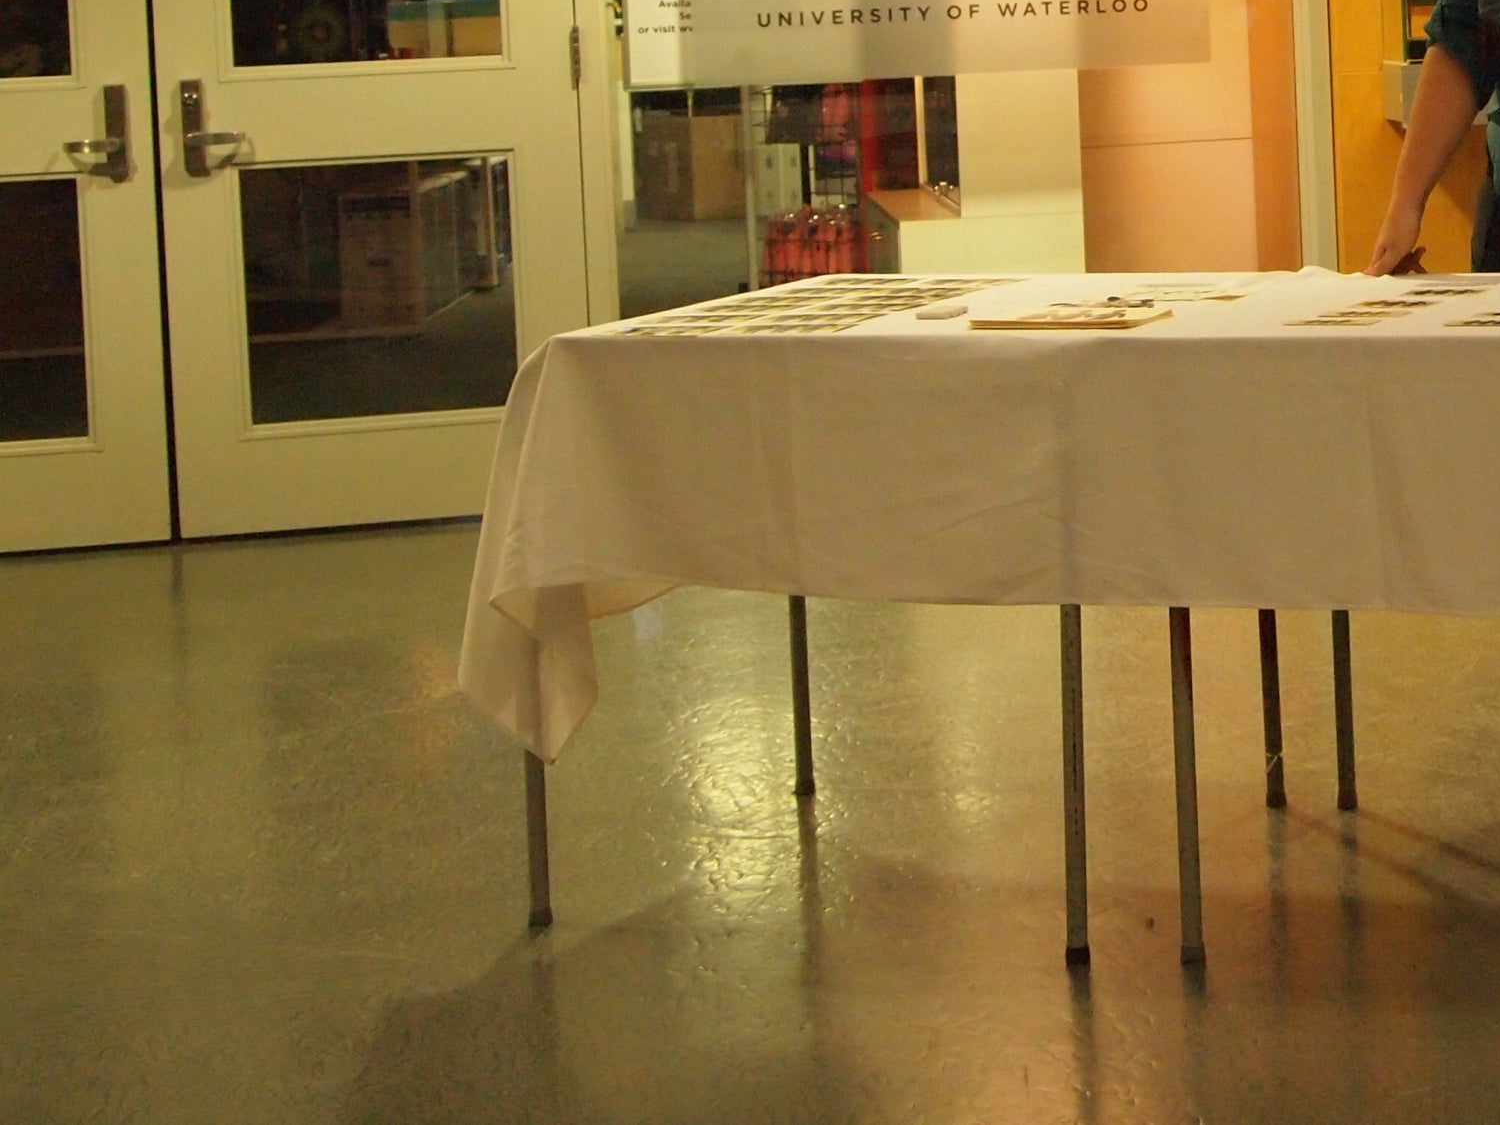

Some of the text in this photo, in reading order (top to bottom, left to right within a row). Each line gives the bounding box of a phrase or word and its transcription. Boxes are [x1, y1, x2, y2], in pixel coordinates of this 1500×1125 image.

[757, 6, 931, 28] UNIVERSITY
[946, 3, 980, 20] OF
[653, 25, 675, 34] visit
